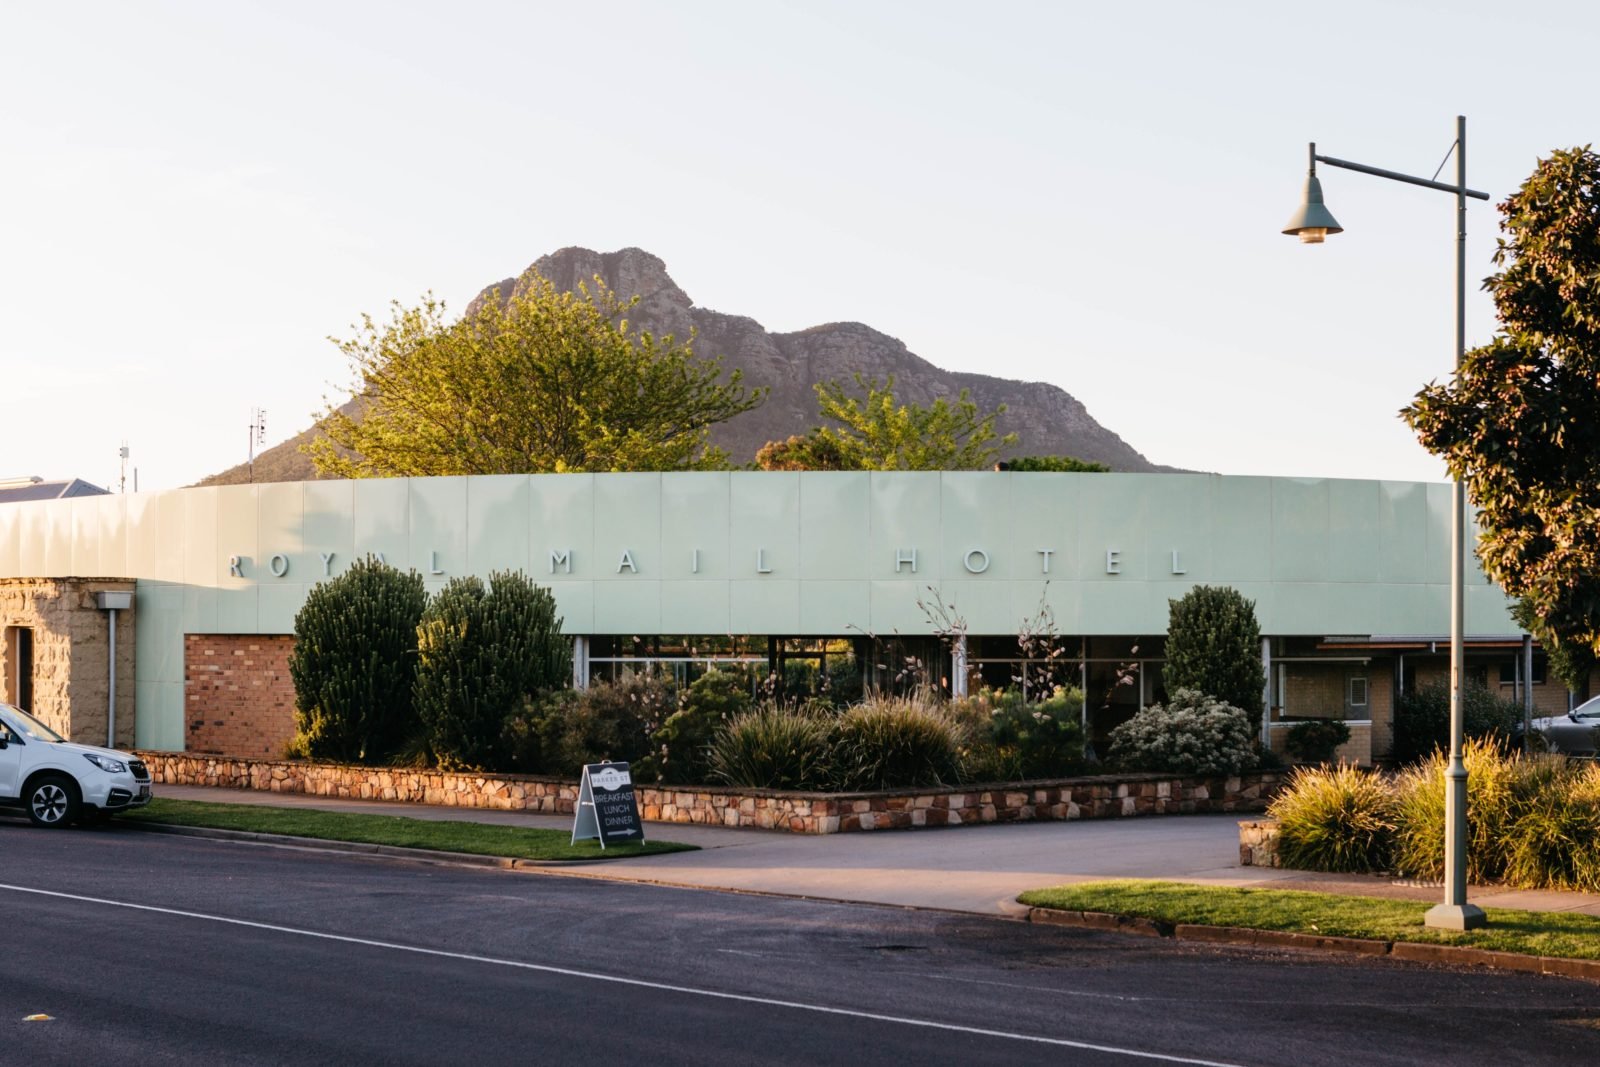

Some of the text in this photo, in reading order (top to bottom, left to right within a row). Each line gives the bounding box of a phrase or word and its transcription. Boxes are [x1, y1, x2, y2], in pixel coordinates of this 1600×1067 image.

[549, 549, 772, 575] MAIL
[895, 548, 1187, 574] HOTEL
[595, 792, 633, 802] BREAKFAST
[604, 805, 630, 814] LUNCH
[605, 816, 633, 826] DINNER
